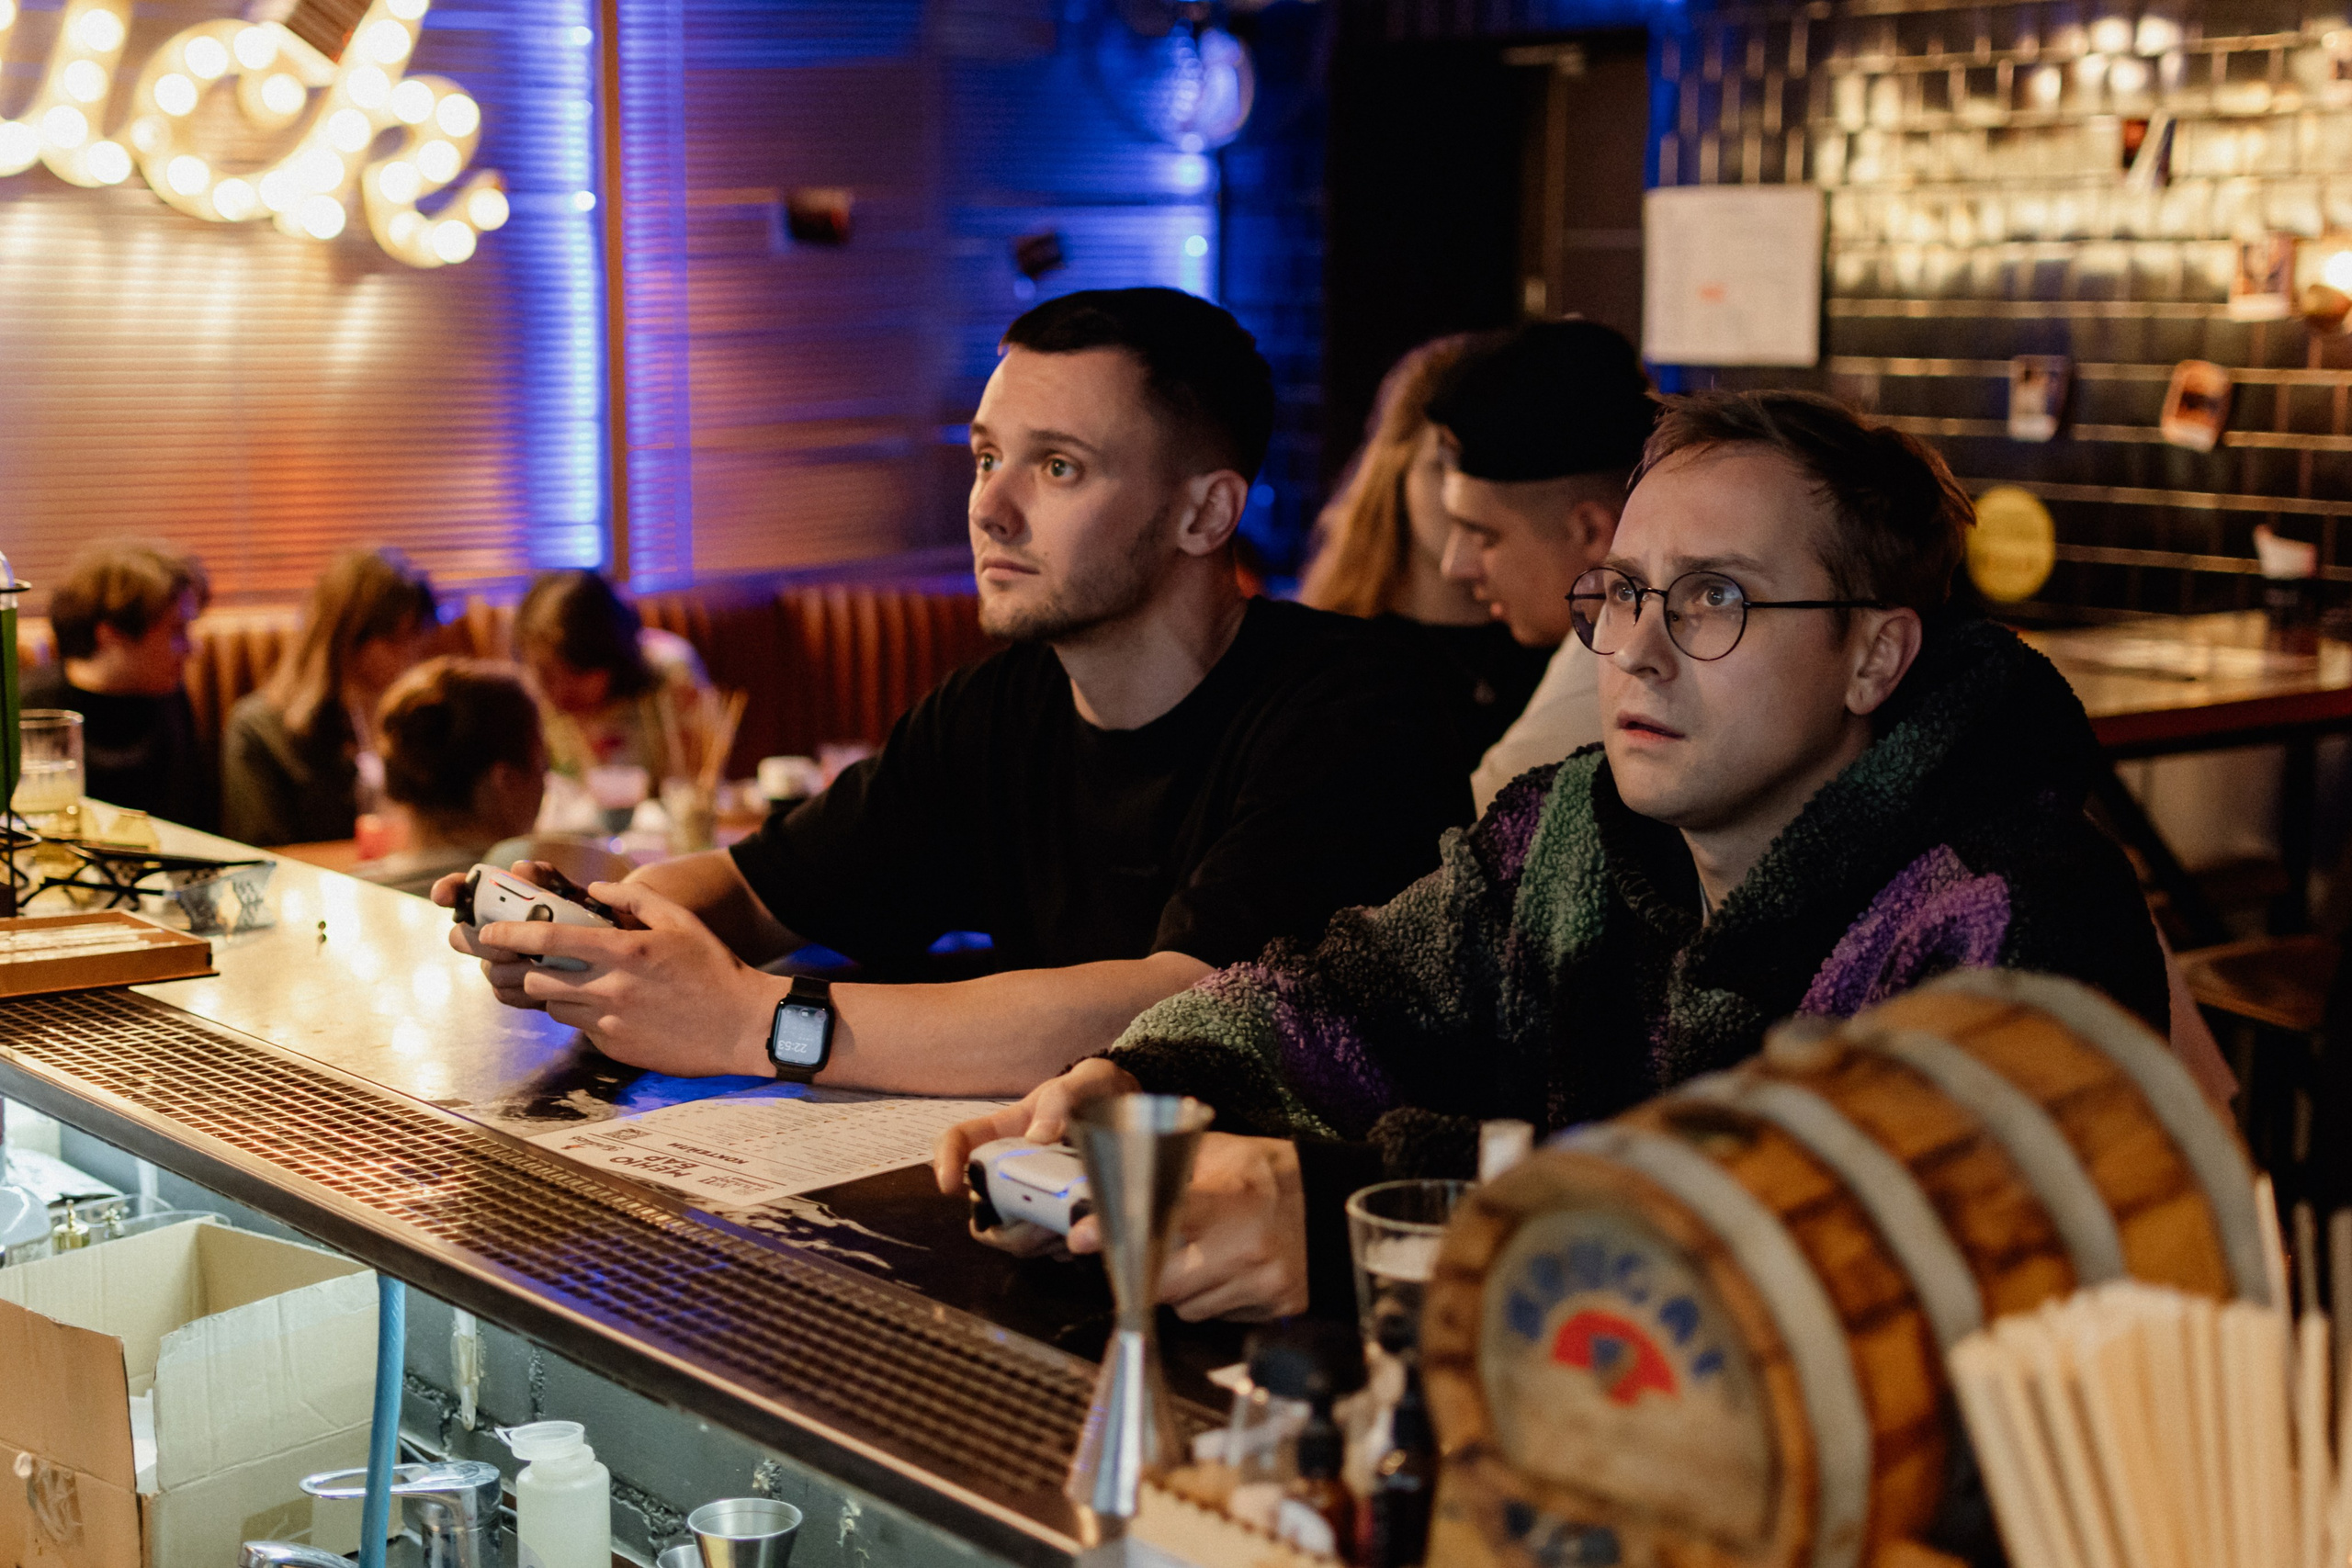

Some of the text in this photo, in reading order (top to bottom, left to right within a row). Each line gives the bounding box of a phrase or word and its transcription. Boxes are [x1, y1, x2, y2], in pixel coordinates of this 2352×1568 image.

[778, 1041, 808, 1053] 22:53
[668, 1142, 749, 1164] КОКТЕЙЛИ
[609, 1156, 692, 1178] МЕНЮ
[643, 1156, 699, 1169] БАР
